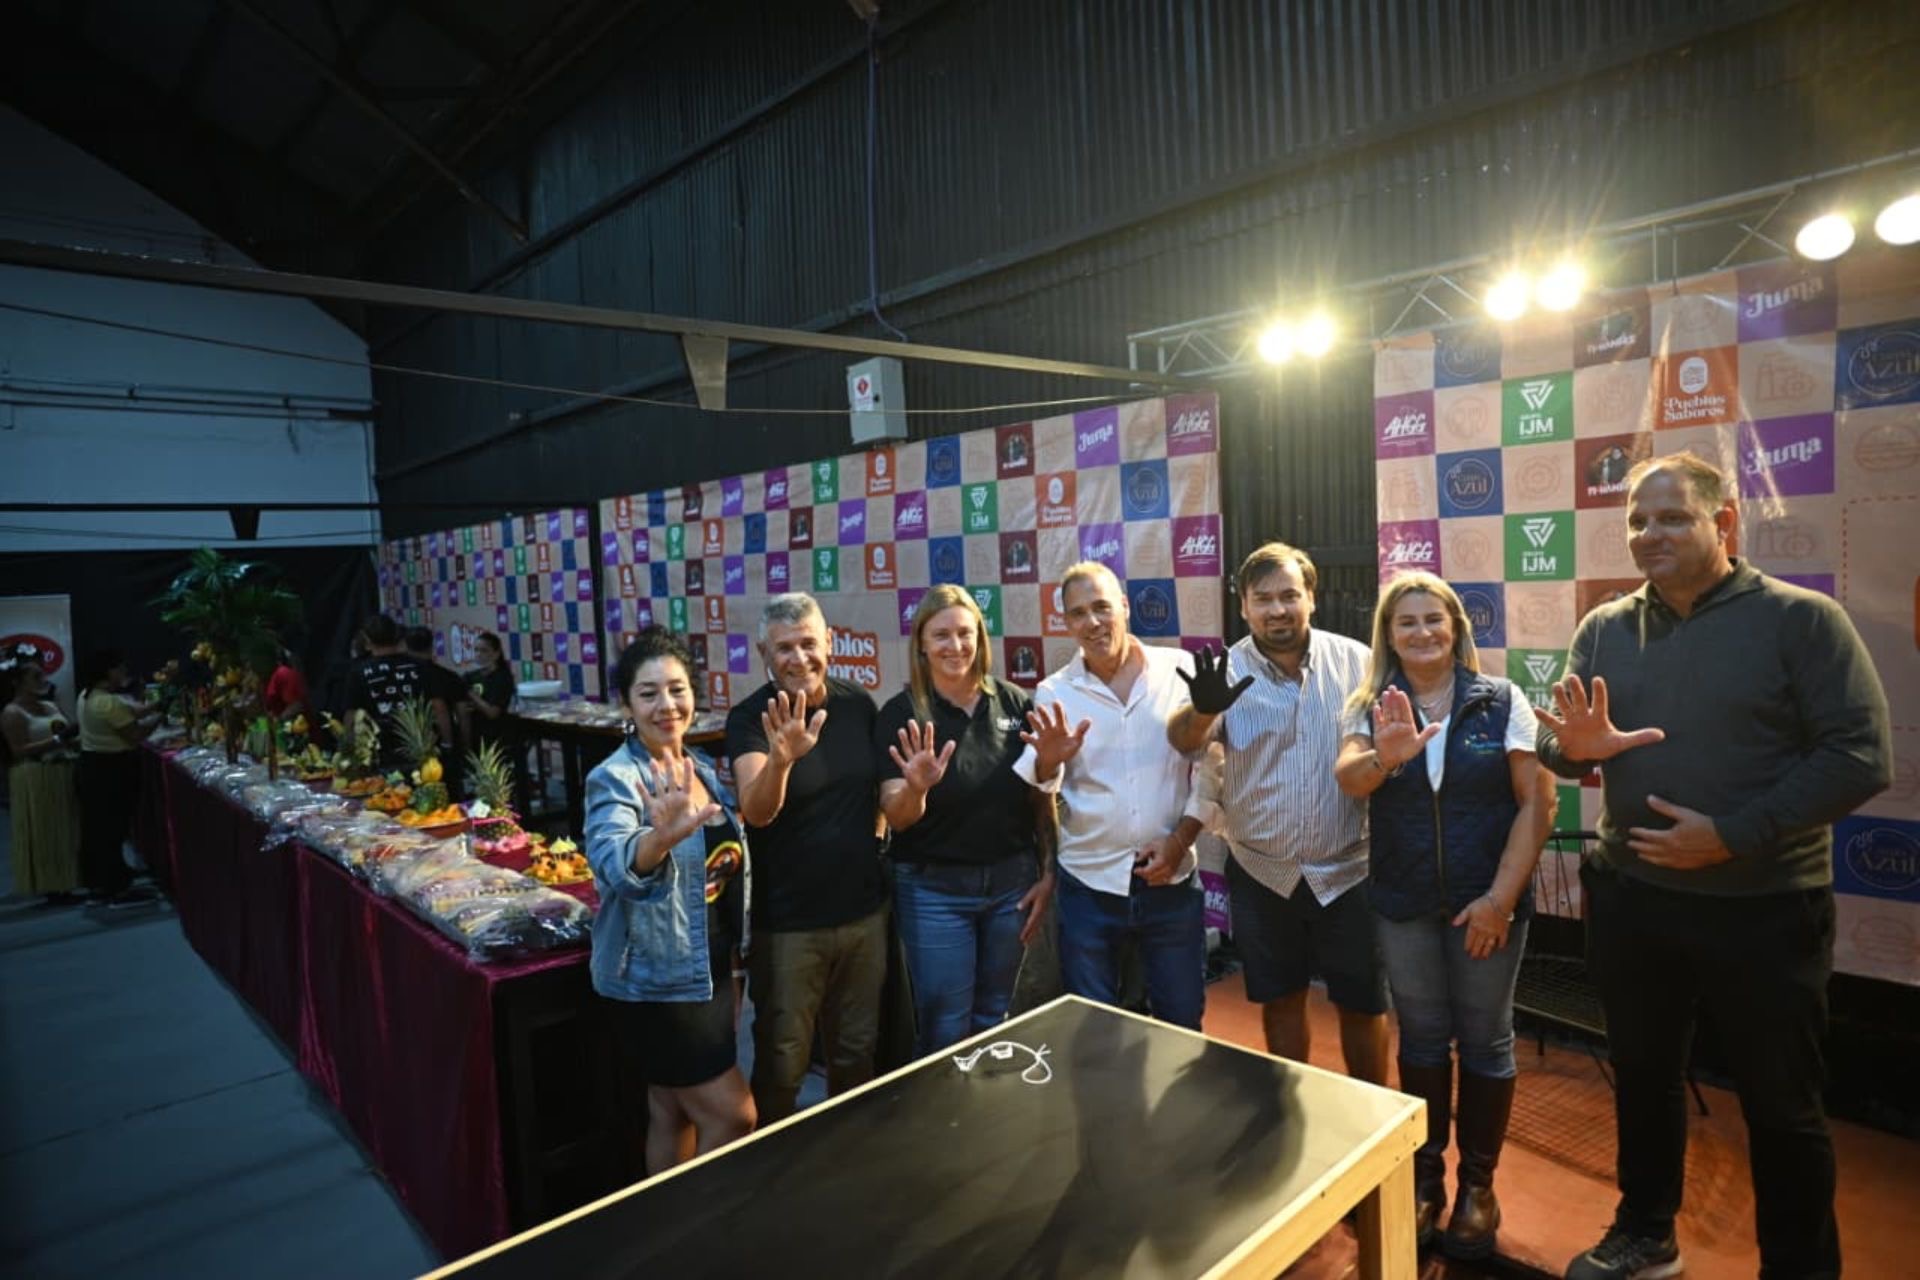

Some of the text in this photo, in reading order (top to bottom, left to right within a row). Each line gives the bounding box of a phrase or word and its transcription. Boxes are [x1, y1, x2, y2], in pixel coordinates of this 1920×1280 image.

[1745, 273, 1825, 319] Juma
[1078, 424, 1114, 452] Juma
[1519, 417, 1554, 436] IJM
[1743, 435, 1823, 475] Juma
[1522, 556, 1557, 572] IJM
[832, 630, 876, 657] blos
